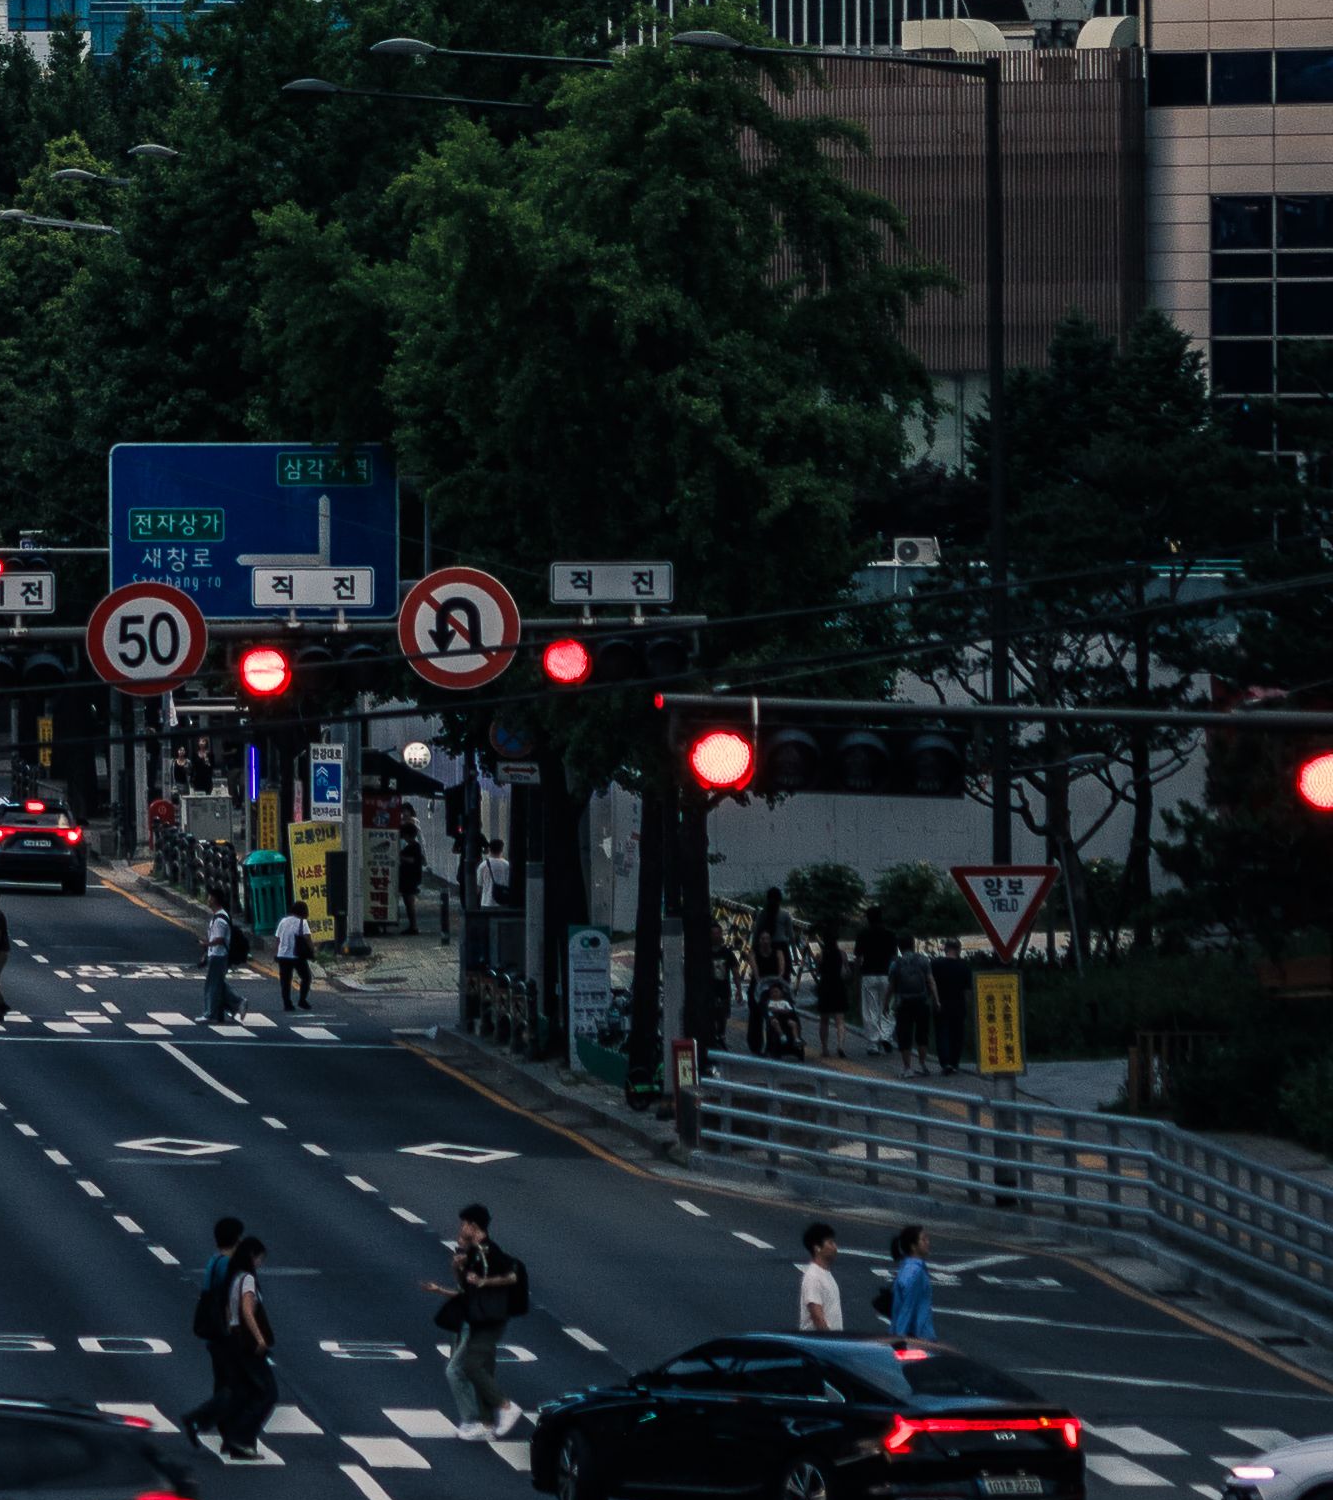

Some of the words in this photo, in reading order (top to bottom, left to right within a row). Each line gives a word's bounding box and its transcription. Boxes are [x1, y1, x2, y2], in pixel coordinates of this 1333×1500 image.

[284, 458, 368, 481] 삼각역
[133, 513, 221, 536] 전자상가
[141, 547, 213, 573] 새창로
[118, 611, 181, 669] 50
[293, 825, 337, 845] 교통안내
[984, 877, 1025, 896] 양보
[989, 898, 1019, 912] YIELD
